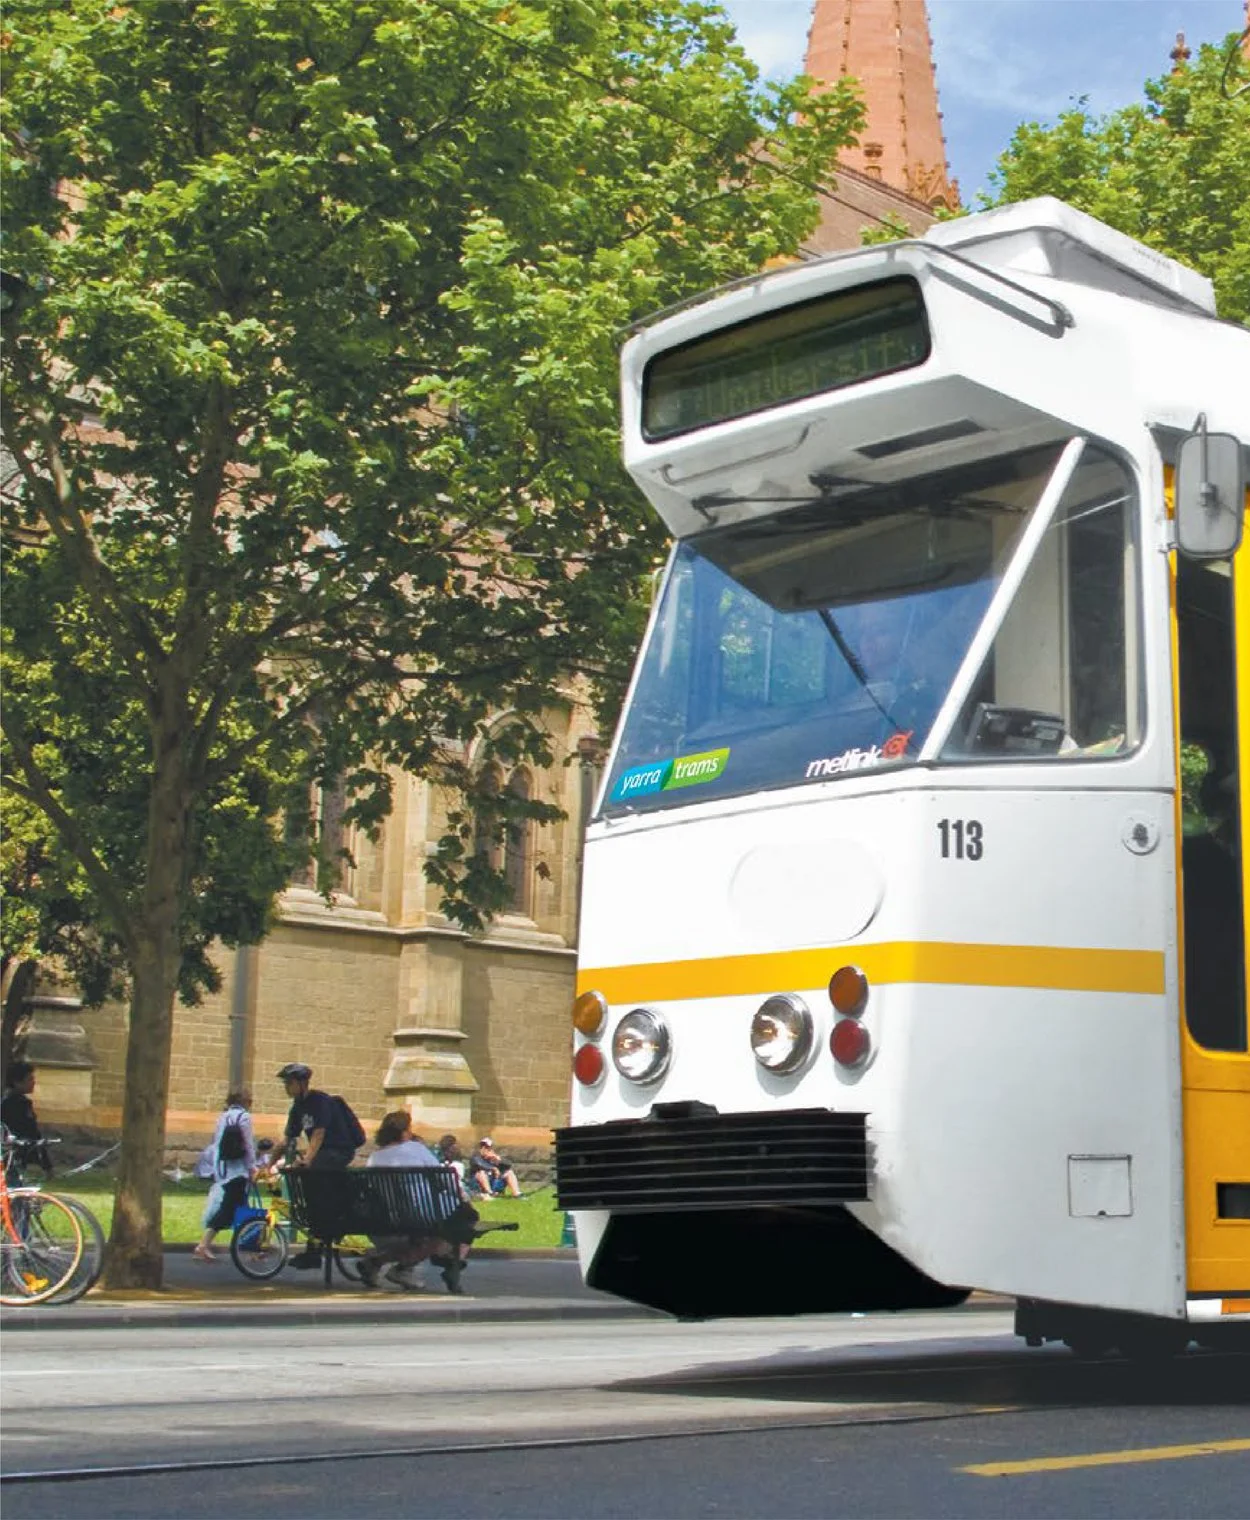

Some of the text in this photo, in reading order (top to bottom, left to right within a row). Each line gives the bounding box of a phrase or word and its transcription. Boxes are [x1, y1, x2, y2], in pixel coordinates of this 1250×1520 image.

[620, 757, 720, 796] yarra trams
[805, 744, 882, 778] metlink
[937, 818, 983, 861] 113
